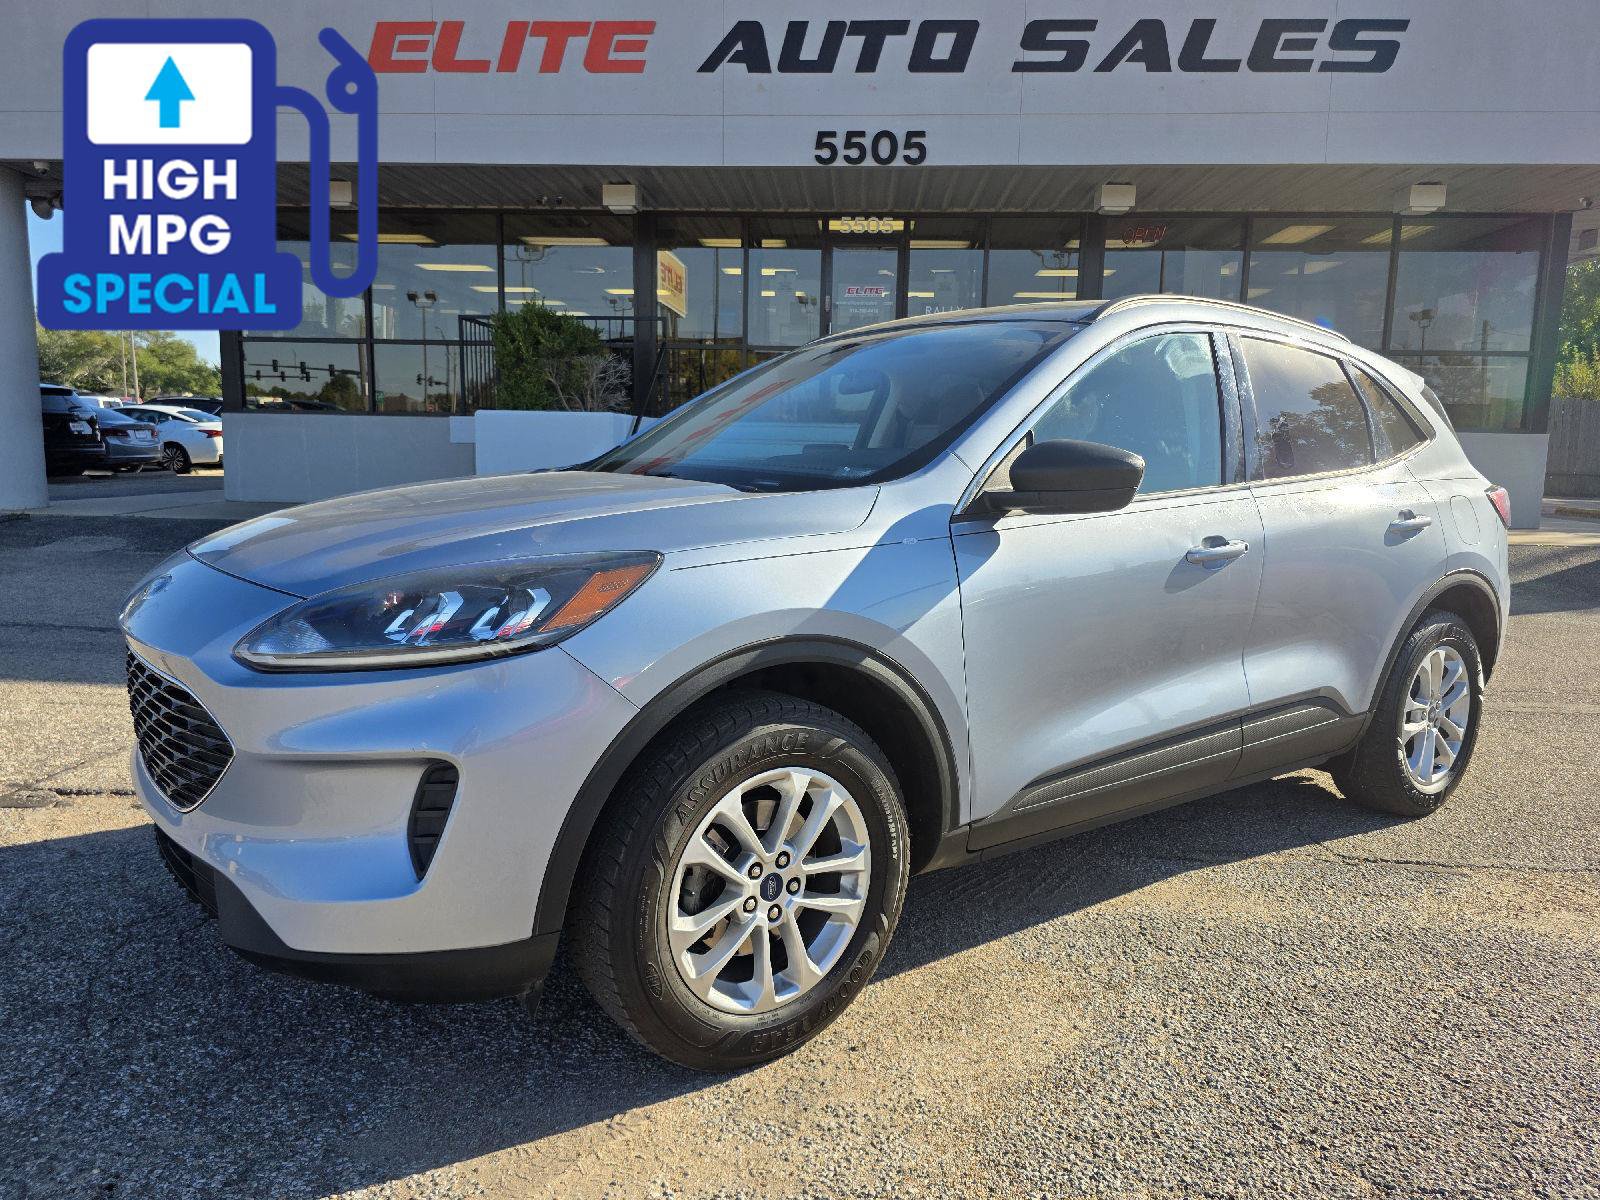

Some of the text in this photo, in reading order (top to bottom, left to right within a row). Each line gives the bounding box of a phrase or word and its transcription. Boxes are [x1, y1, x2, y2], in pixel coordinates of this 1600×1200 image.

[367, 19, 1410, 73] ELITE AUTO SALES
[814, 130, 928, 166] 5505
[840, 217, 894, 234] 5505
[846, 286, 885, 295] ELITE
[675, 732, 809, 826] ASSURANCE
